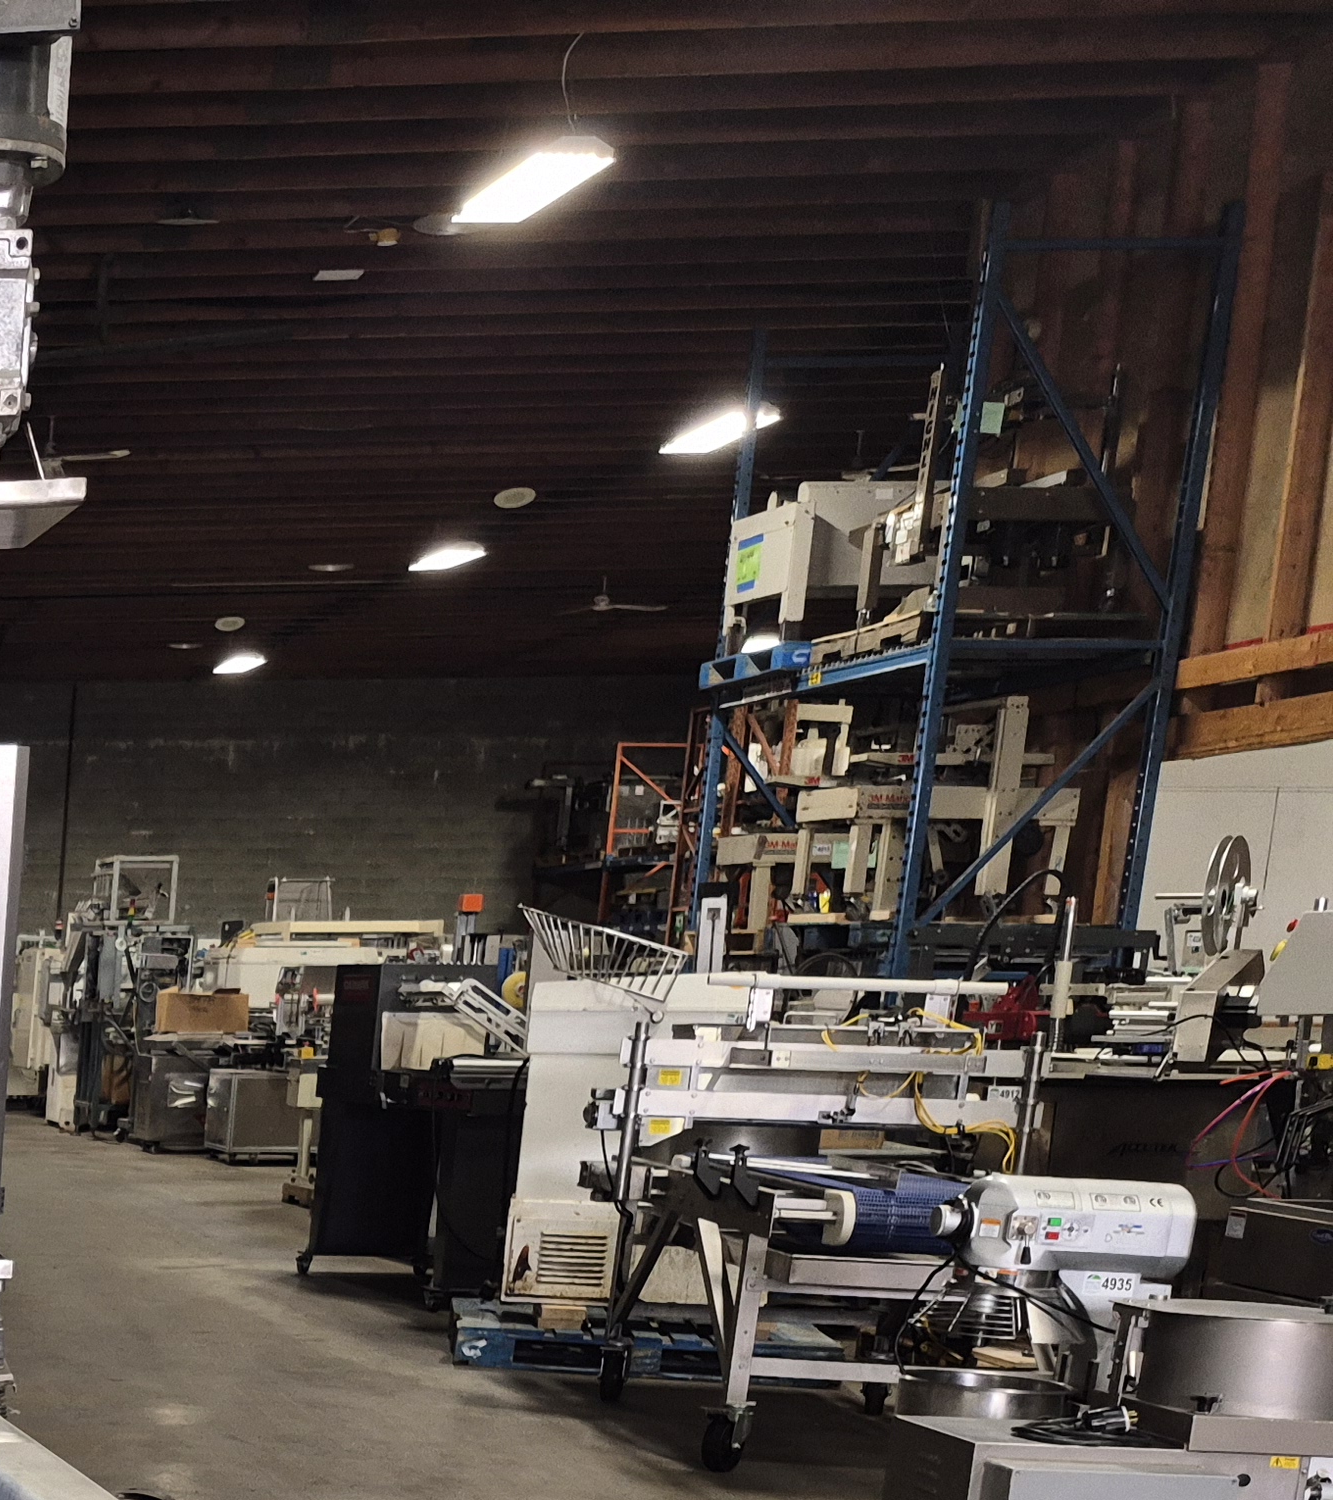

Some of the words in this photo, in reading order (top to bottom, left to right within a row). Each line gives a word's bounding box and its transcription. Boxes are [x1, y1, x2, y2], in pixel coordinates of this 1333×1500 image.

[898, 754, 915, 763] 3M
[805, 777, 821, 786] 3M
[1101, 1278, 1133, 1291] 4935
